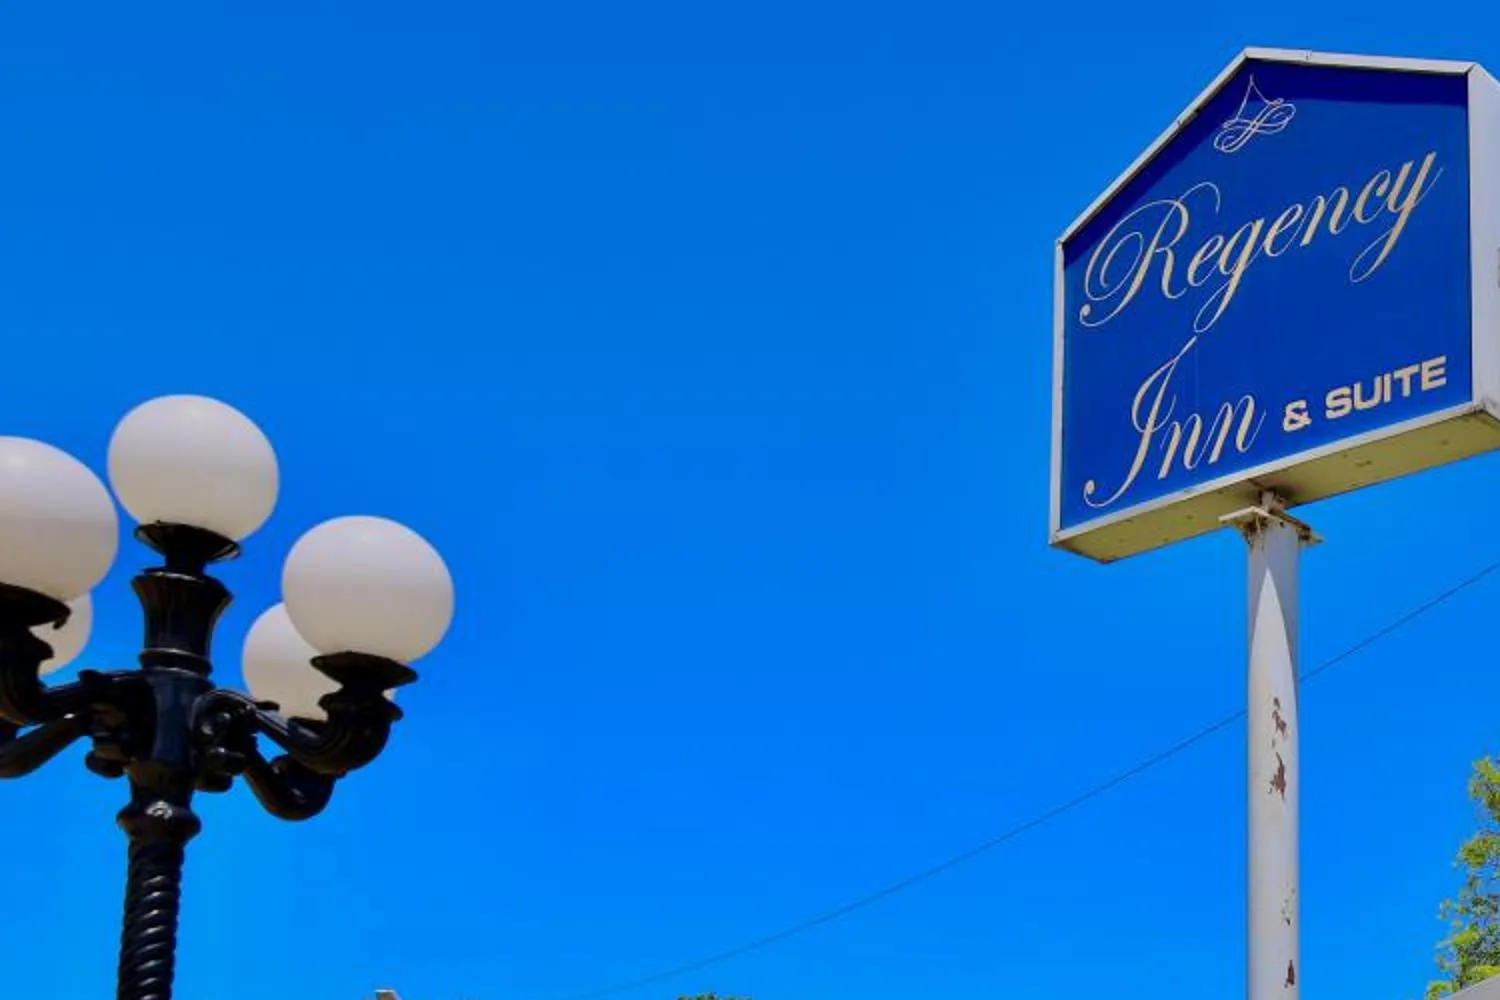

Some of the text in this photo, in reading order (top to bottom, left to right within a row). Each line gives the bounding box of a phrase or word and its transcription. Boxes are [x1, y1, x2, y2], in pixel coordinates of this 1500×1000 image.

[1079, 152, 1444, 333] Regency
[1083, 335, 1447, 507] Inn & SUITE
